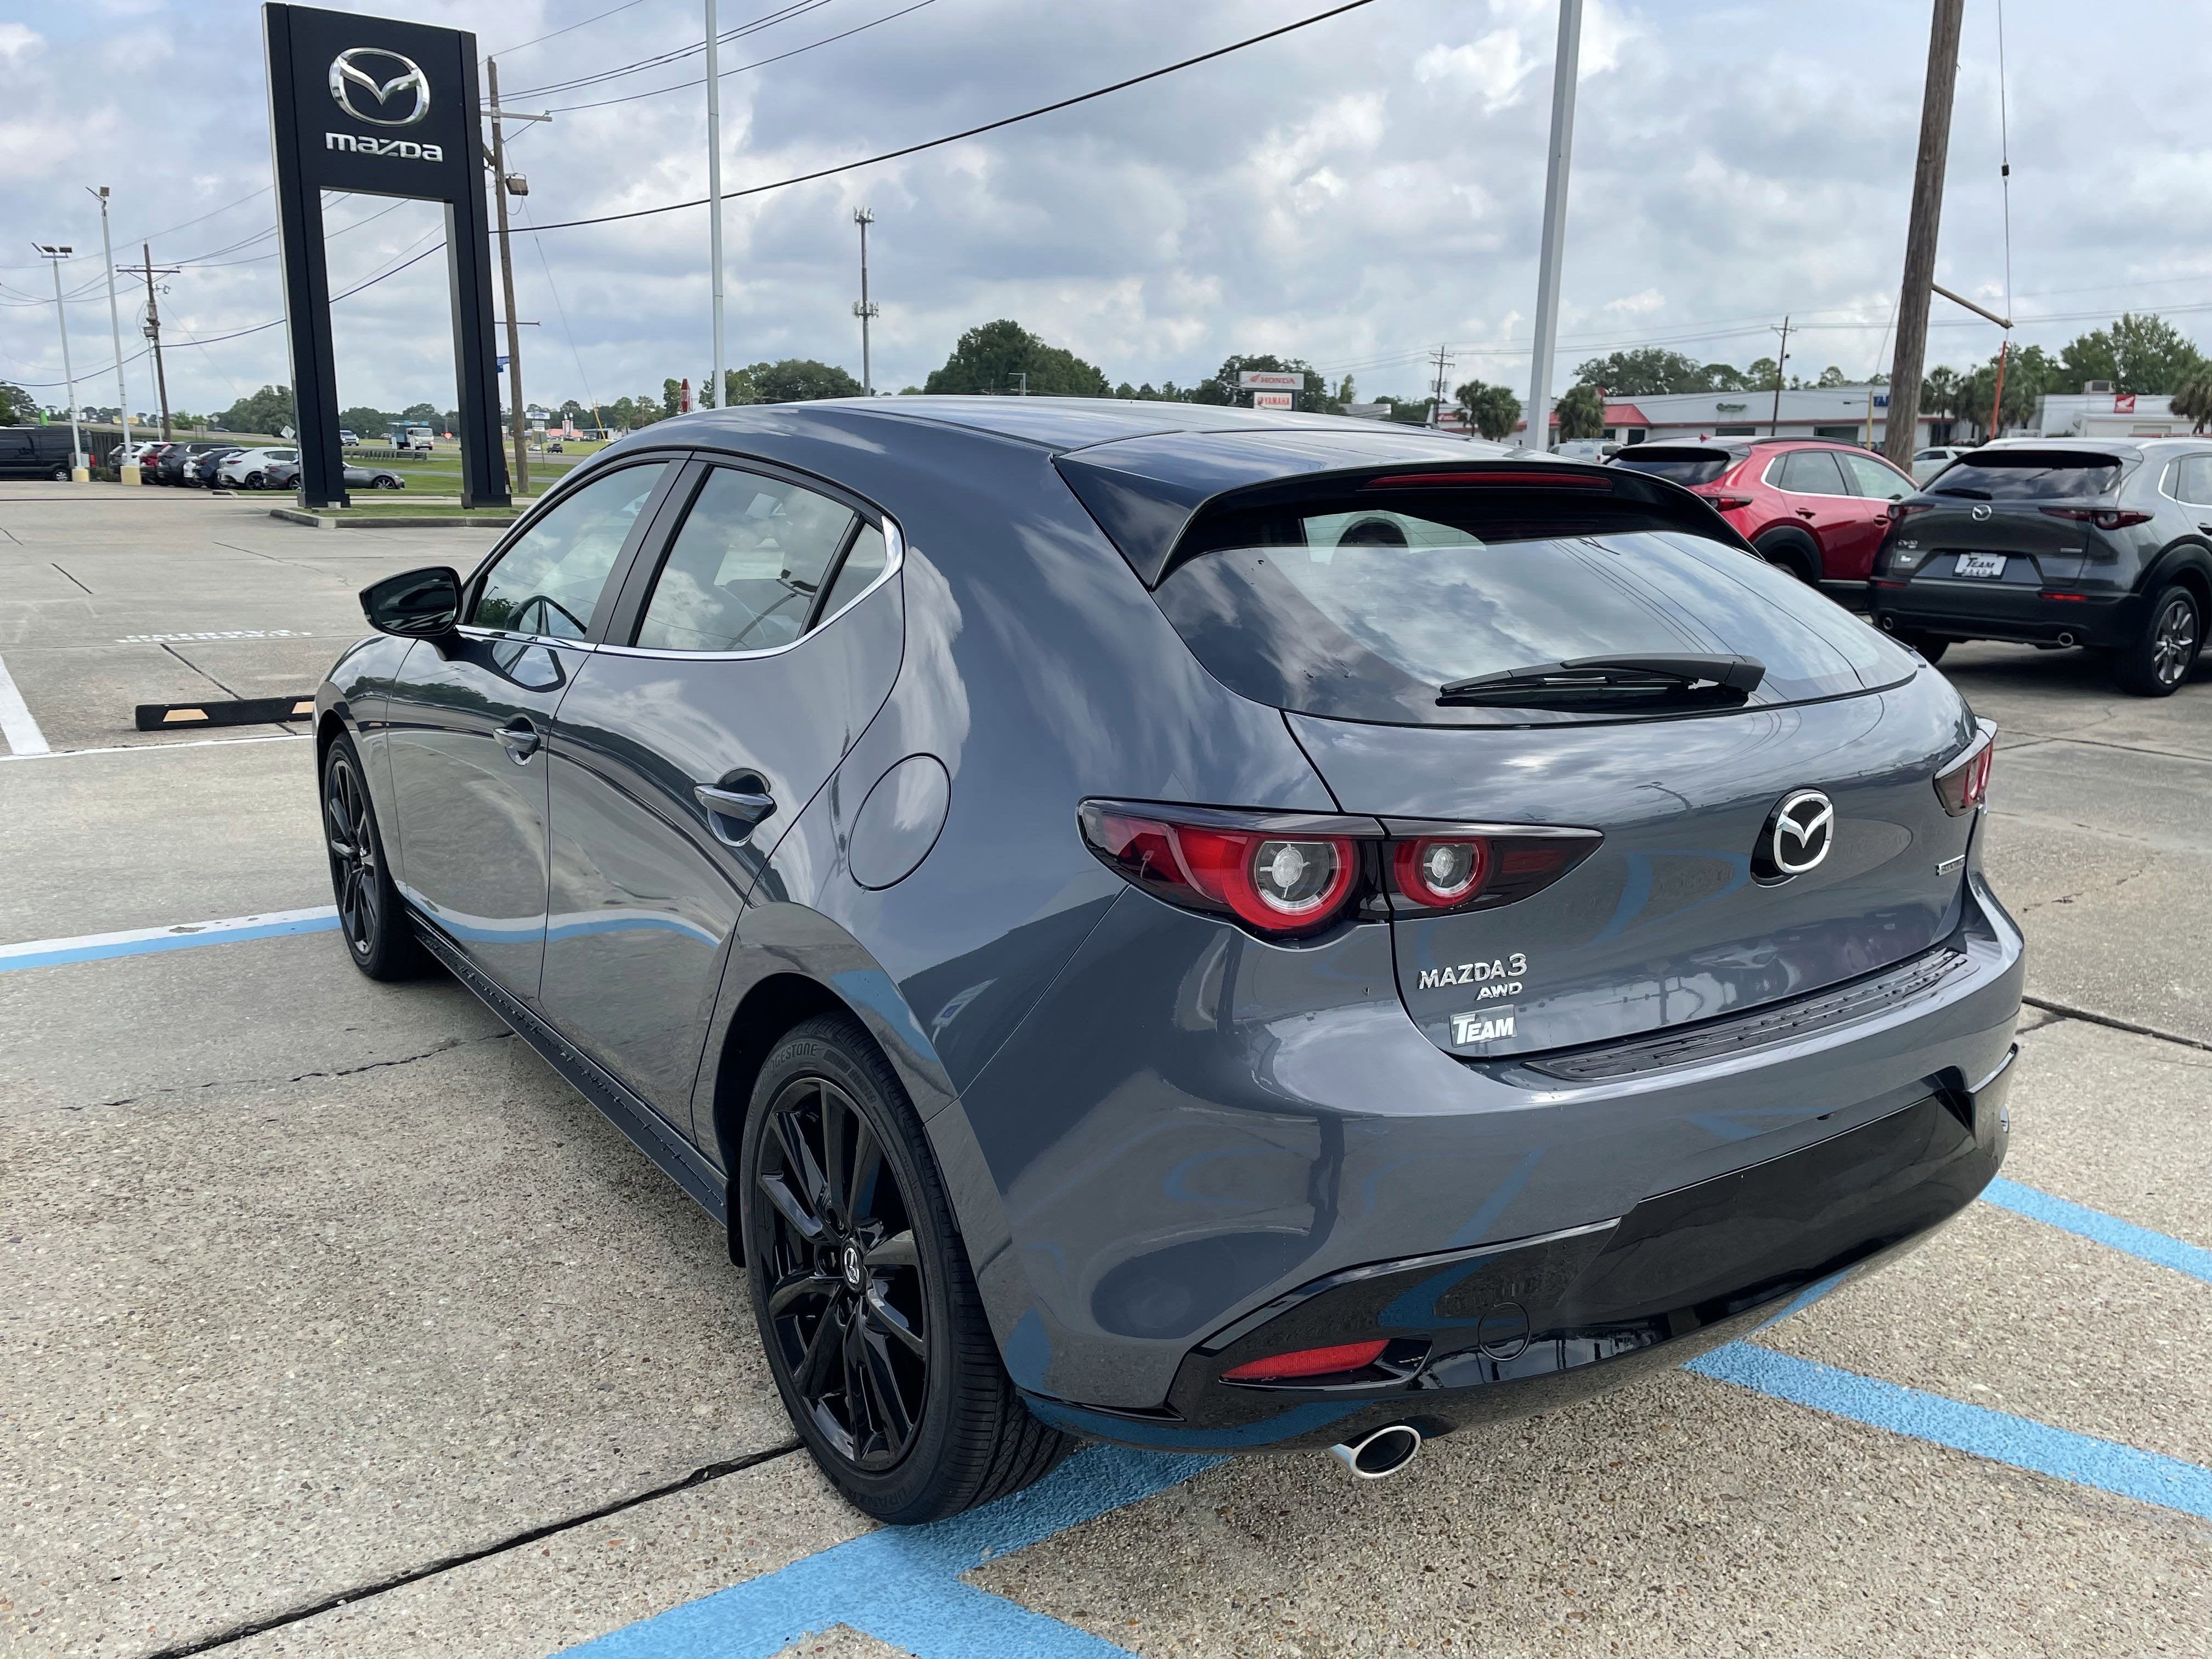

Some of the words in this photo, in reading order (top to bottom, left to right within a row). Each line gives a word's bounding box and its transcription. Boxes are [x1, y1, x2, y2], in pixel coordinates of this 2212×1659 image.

[1967, 557, 1995, 568] TEAM
[1419, 953, 1527, 990] MAZDA3
[1475, 981, 1523, 1001] AWD
[1453, 1013, 1514, 1045] TEAM
